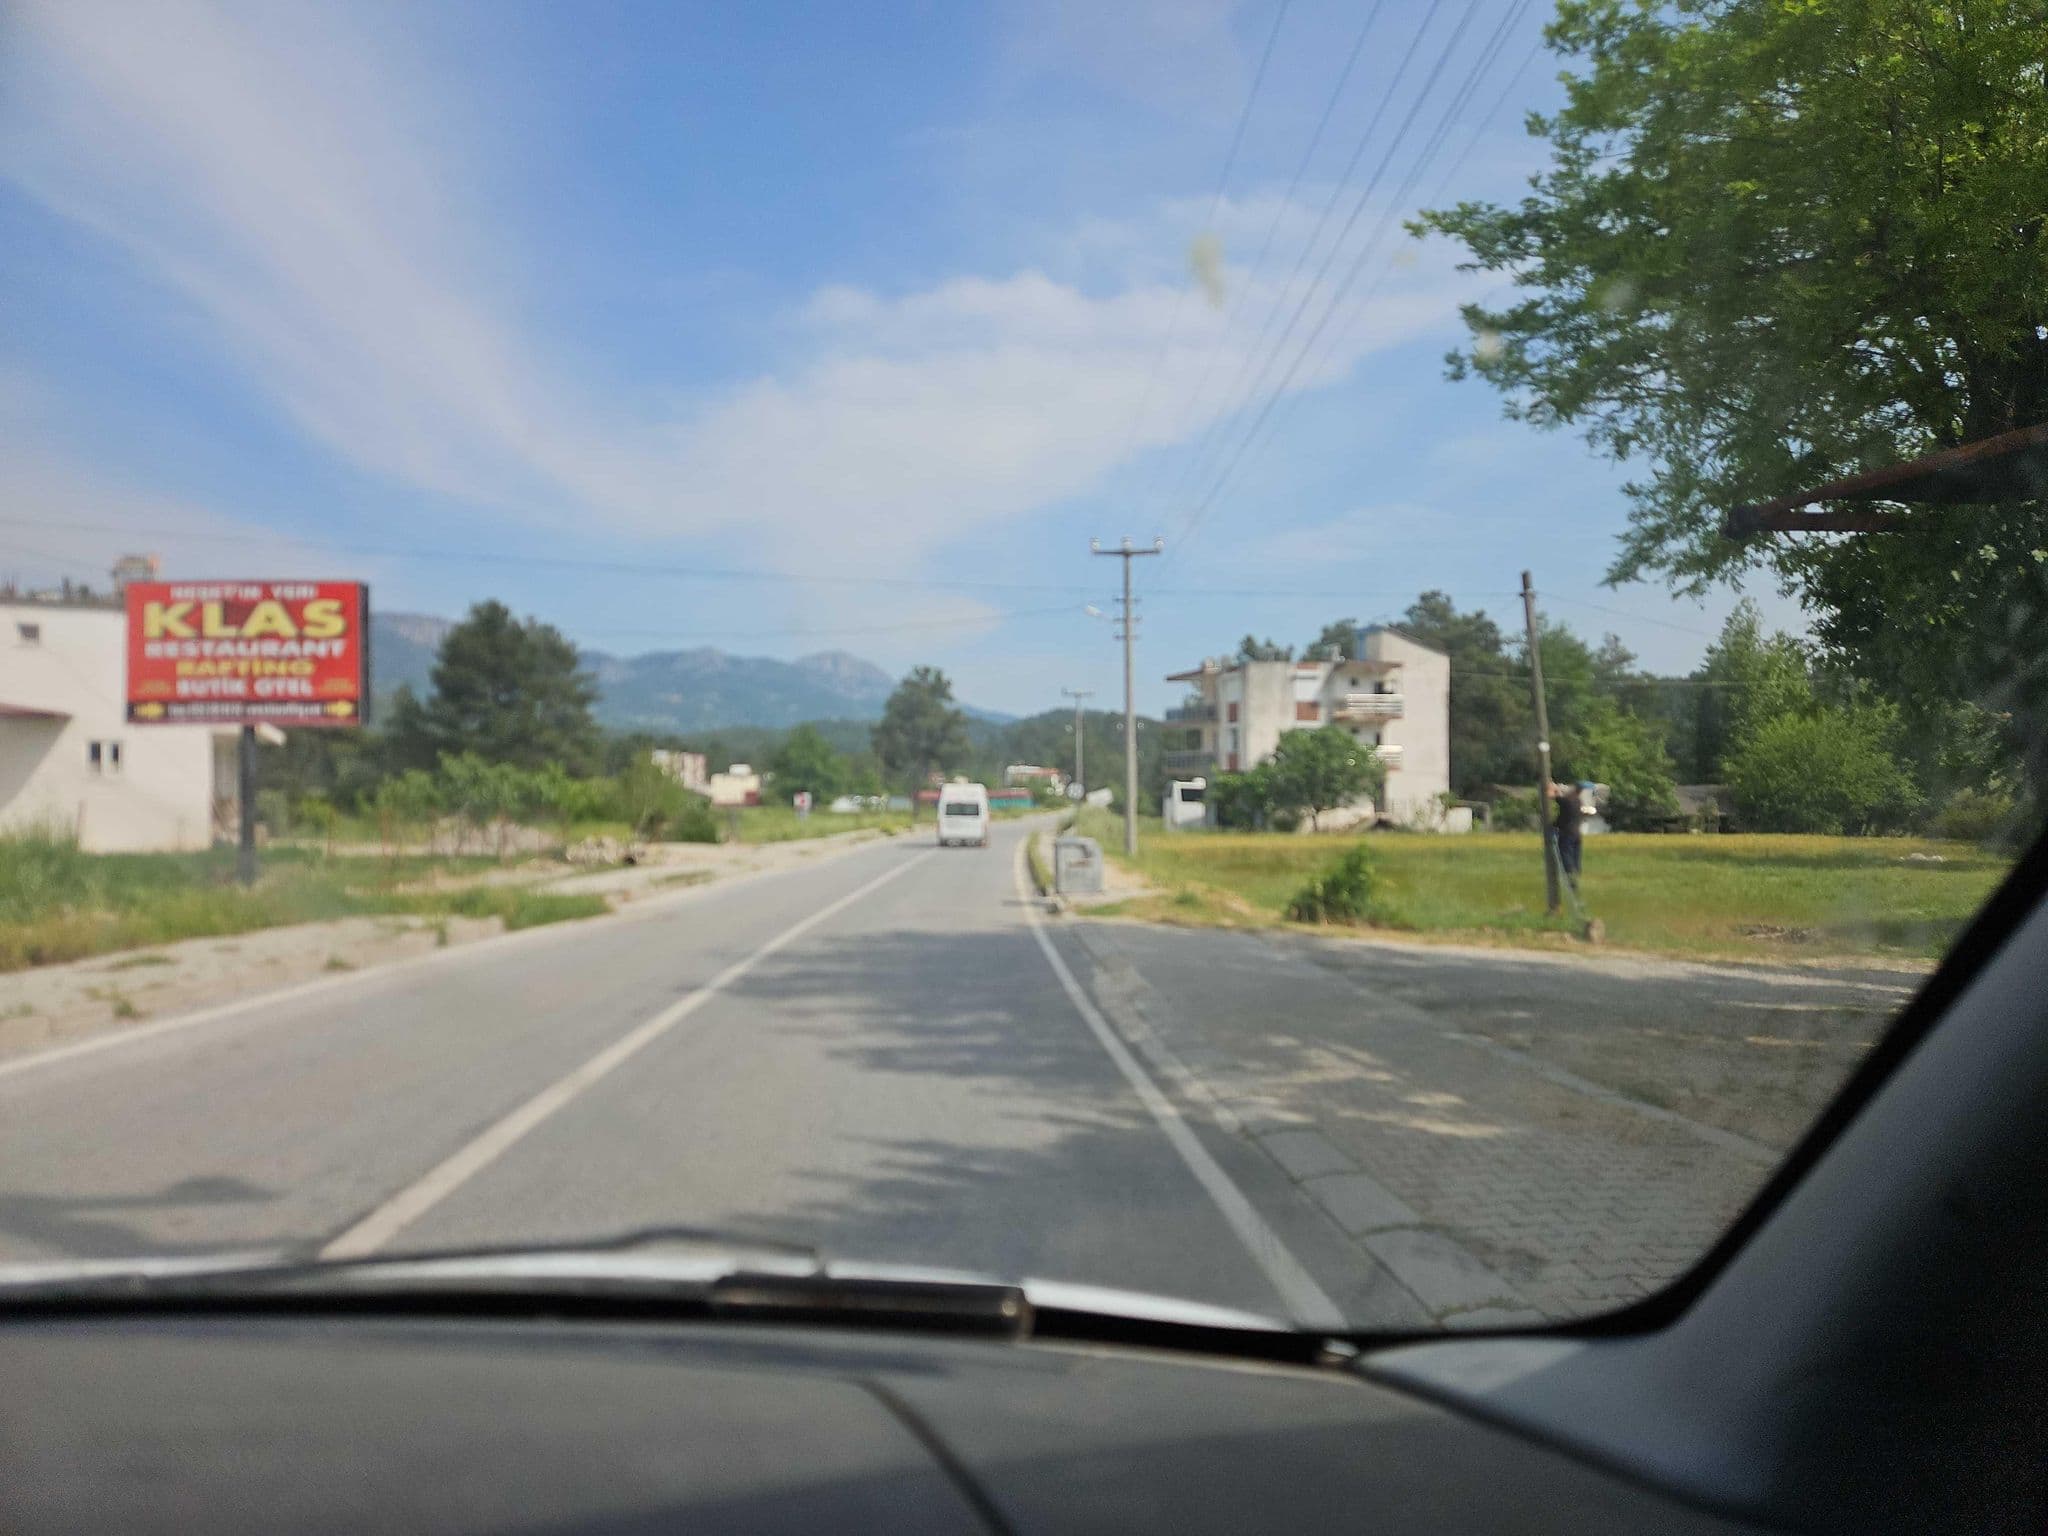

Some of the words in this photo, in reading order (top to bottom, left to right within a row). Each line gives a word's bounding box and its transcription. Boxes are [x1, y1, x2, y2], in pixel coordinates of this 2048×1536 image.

[143, 599, 347, 639] KLAS
[144, 639, 347, 659] RESTAURANT
[253, 677, 314, 697] OTEL
